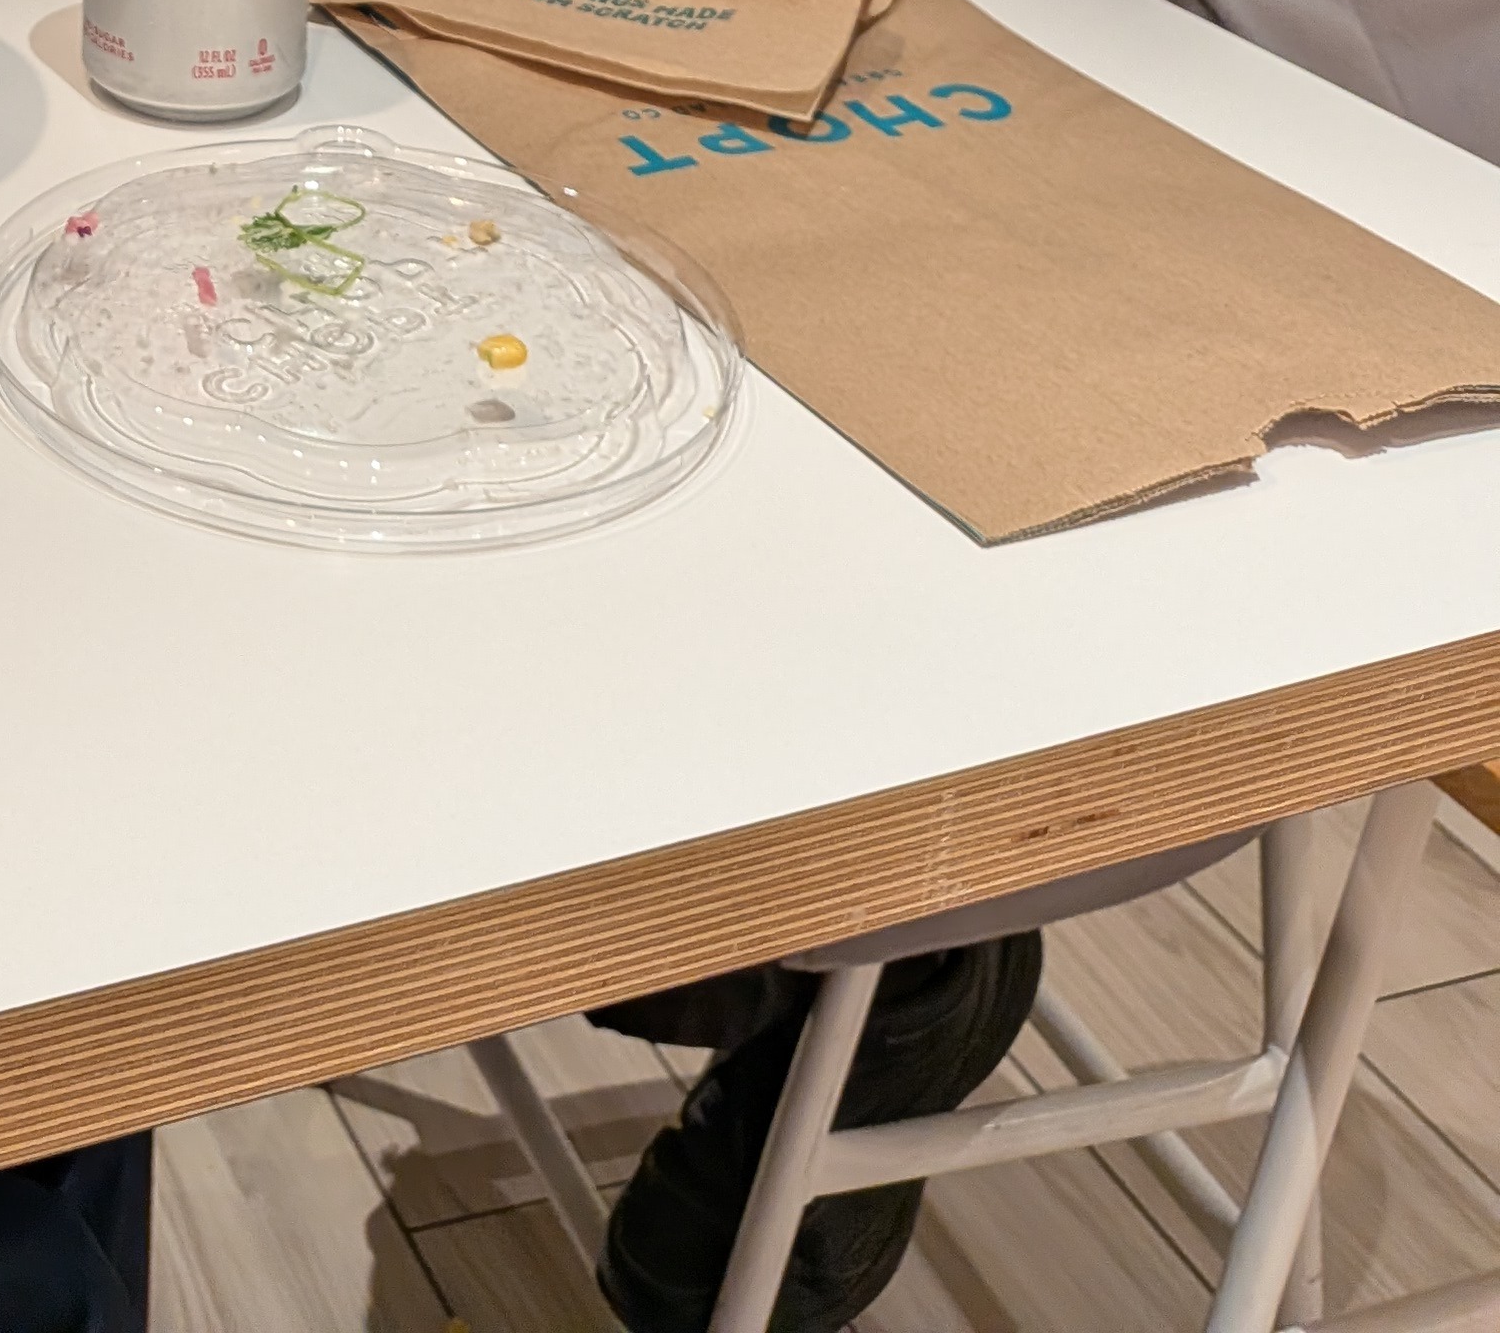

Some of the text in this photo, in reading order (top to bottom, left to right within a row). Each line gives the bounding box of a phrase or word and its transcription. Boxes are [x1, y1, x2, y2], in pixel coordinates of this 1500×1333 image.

[575, 1, 710, 32] SCRATCH
[653, 4, 737, 22] MADE
[618, 82, 1013, 177] CHOPT
